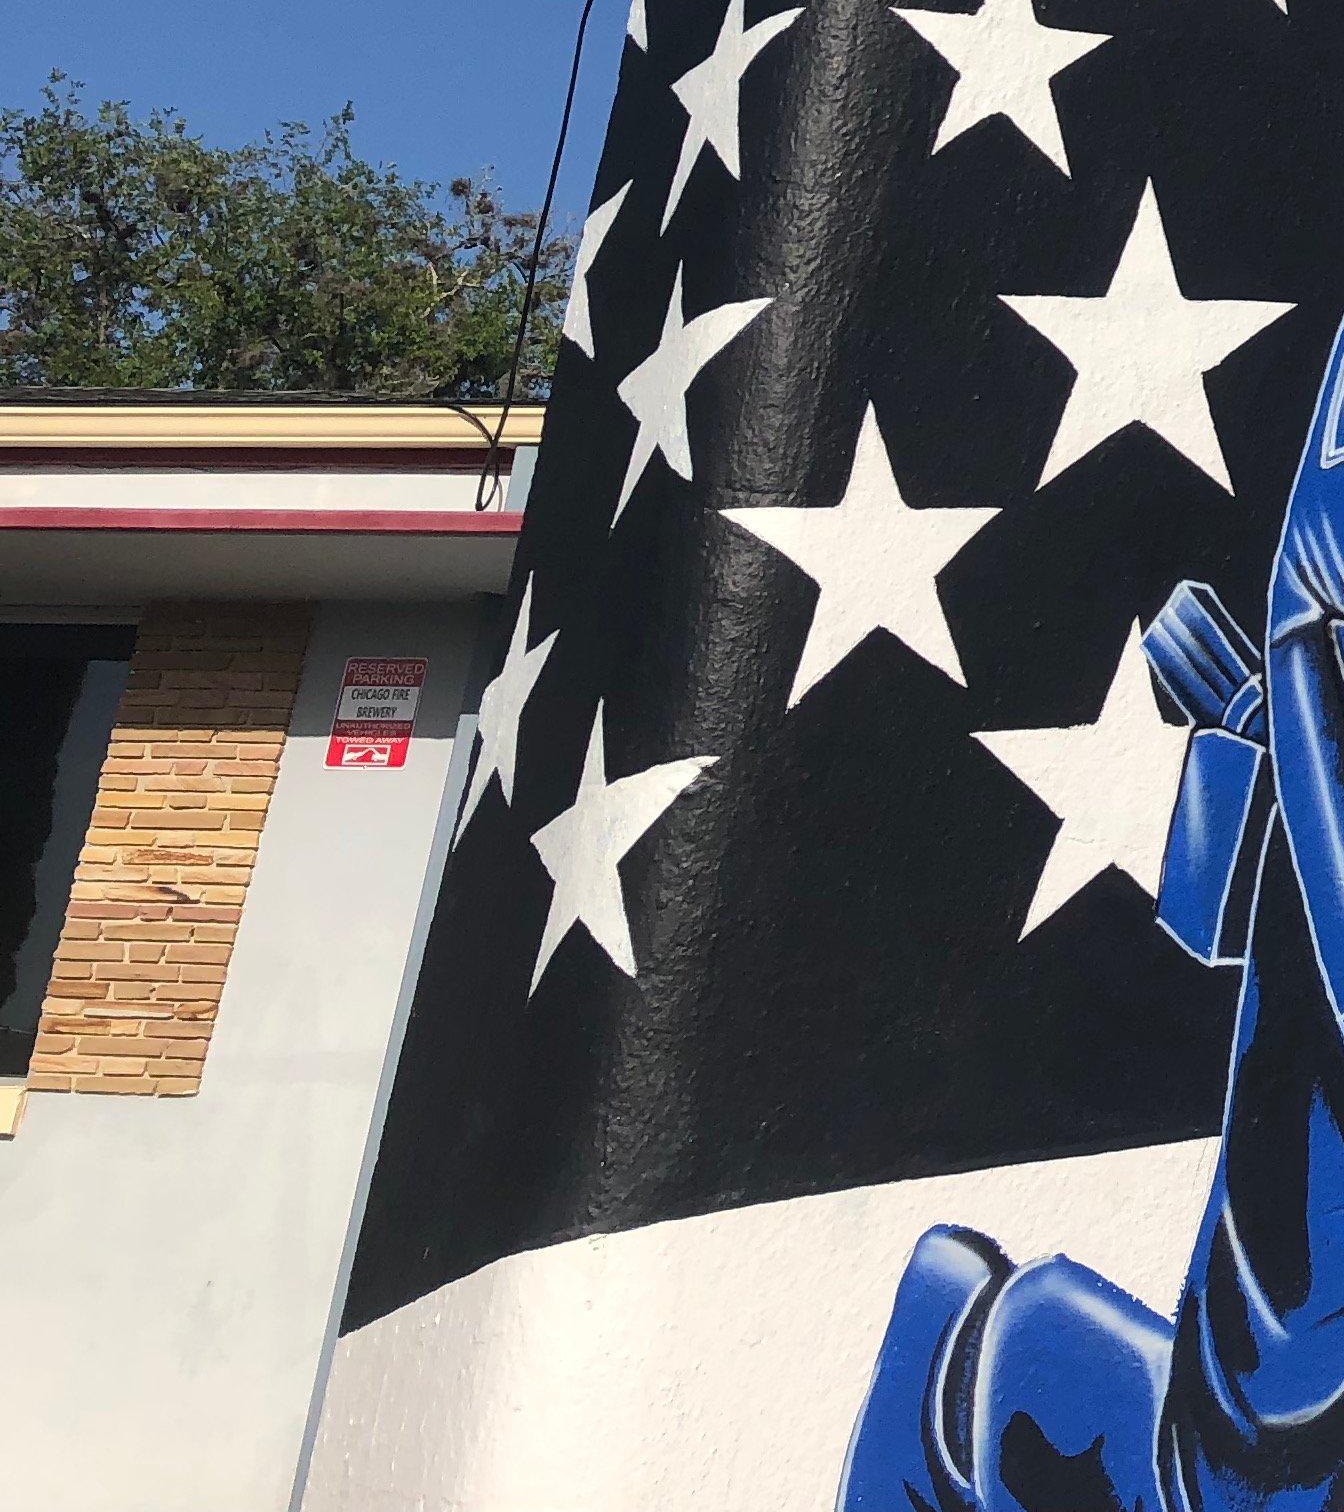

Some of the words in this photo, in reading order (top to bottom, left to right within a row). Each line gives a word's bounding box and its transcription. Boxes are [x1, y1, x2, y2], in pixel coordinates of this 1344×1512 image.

[348, 662, 425, 674] RESERVED
[352, 674, 415, 685] PARKING
[351, 688, 390, 700] CHICAGO
[392, 688, 411, 700] FIRE
[356, 706, 398, 719] BREWERY
[336, 736, 374, 744] TOWED
[375, 736, 405, 744] AWAY
